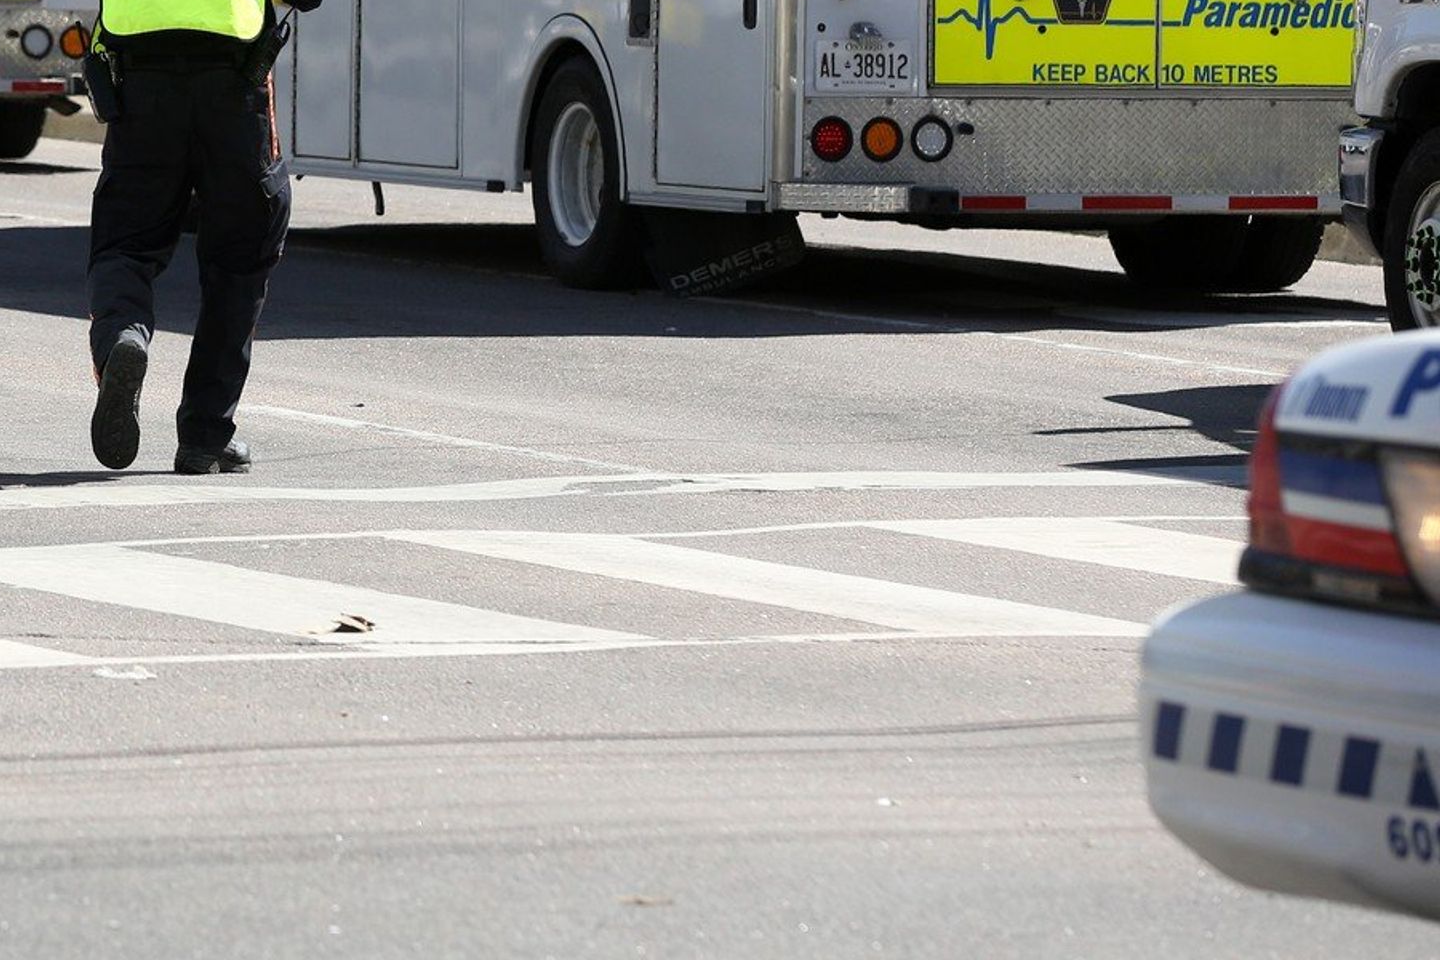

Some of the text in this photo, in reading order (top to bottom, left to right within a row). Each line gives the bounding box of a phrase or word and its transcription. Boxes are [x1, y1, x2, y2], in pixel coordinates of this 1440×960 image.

[1032, 64, 1278, 83] KEEP BACK 10 METRES
[670, 234, 793, 290] DEMERS
[1387, 813, 1440, 863] 60
